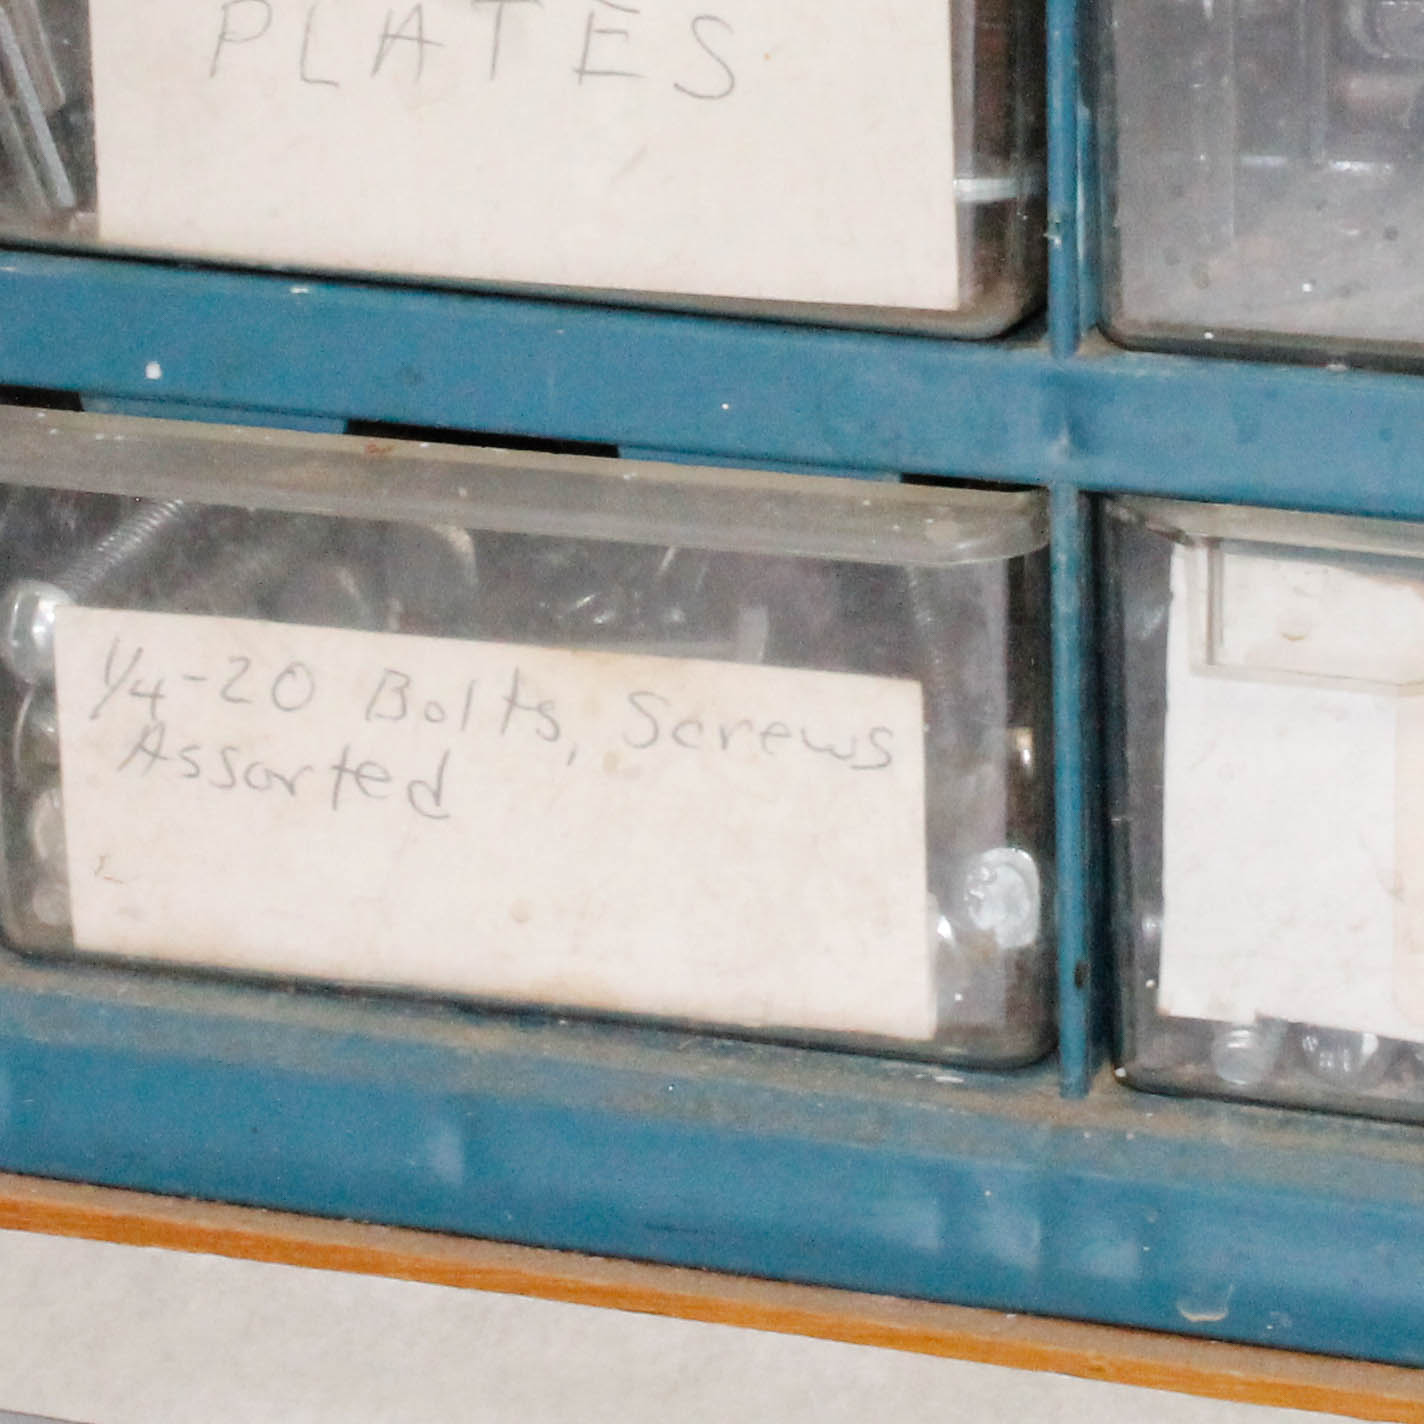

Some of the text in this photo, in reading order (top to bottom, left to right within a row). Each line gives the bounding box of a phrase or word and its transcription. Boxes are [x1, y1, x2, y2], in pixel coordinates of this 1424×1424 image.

[87, 637, 895, 773] 1/4-20 Bolts, Screws
[117, 719, 452, 822] Assorted
